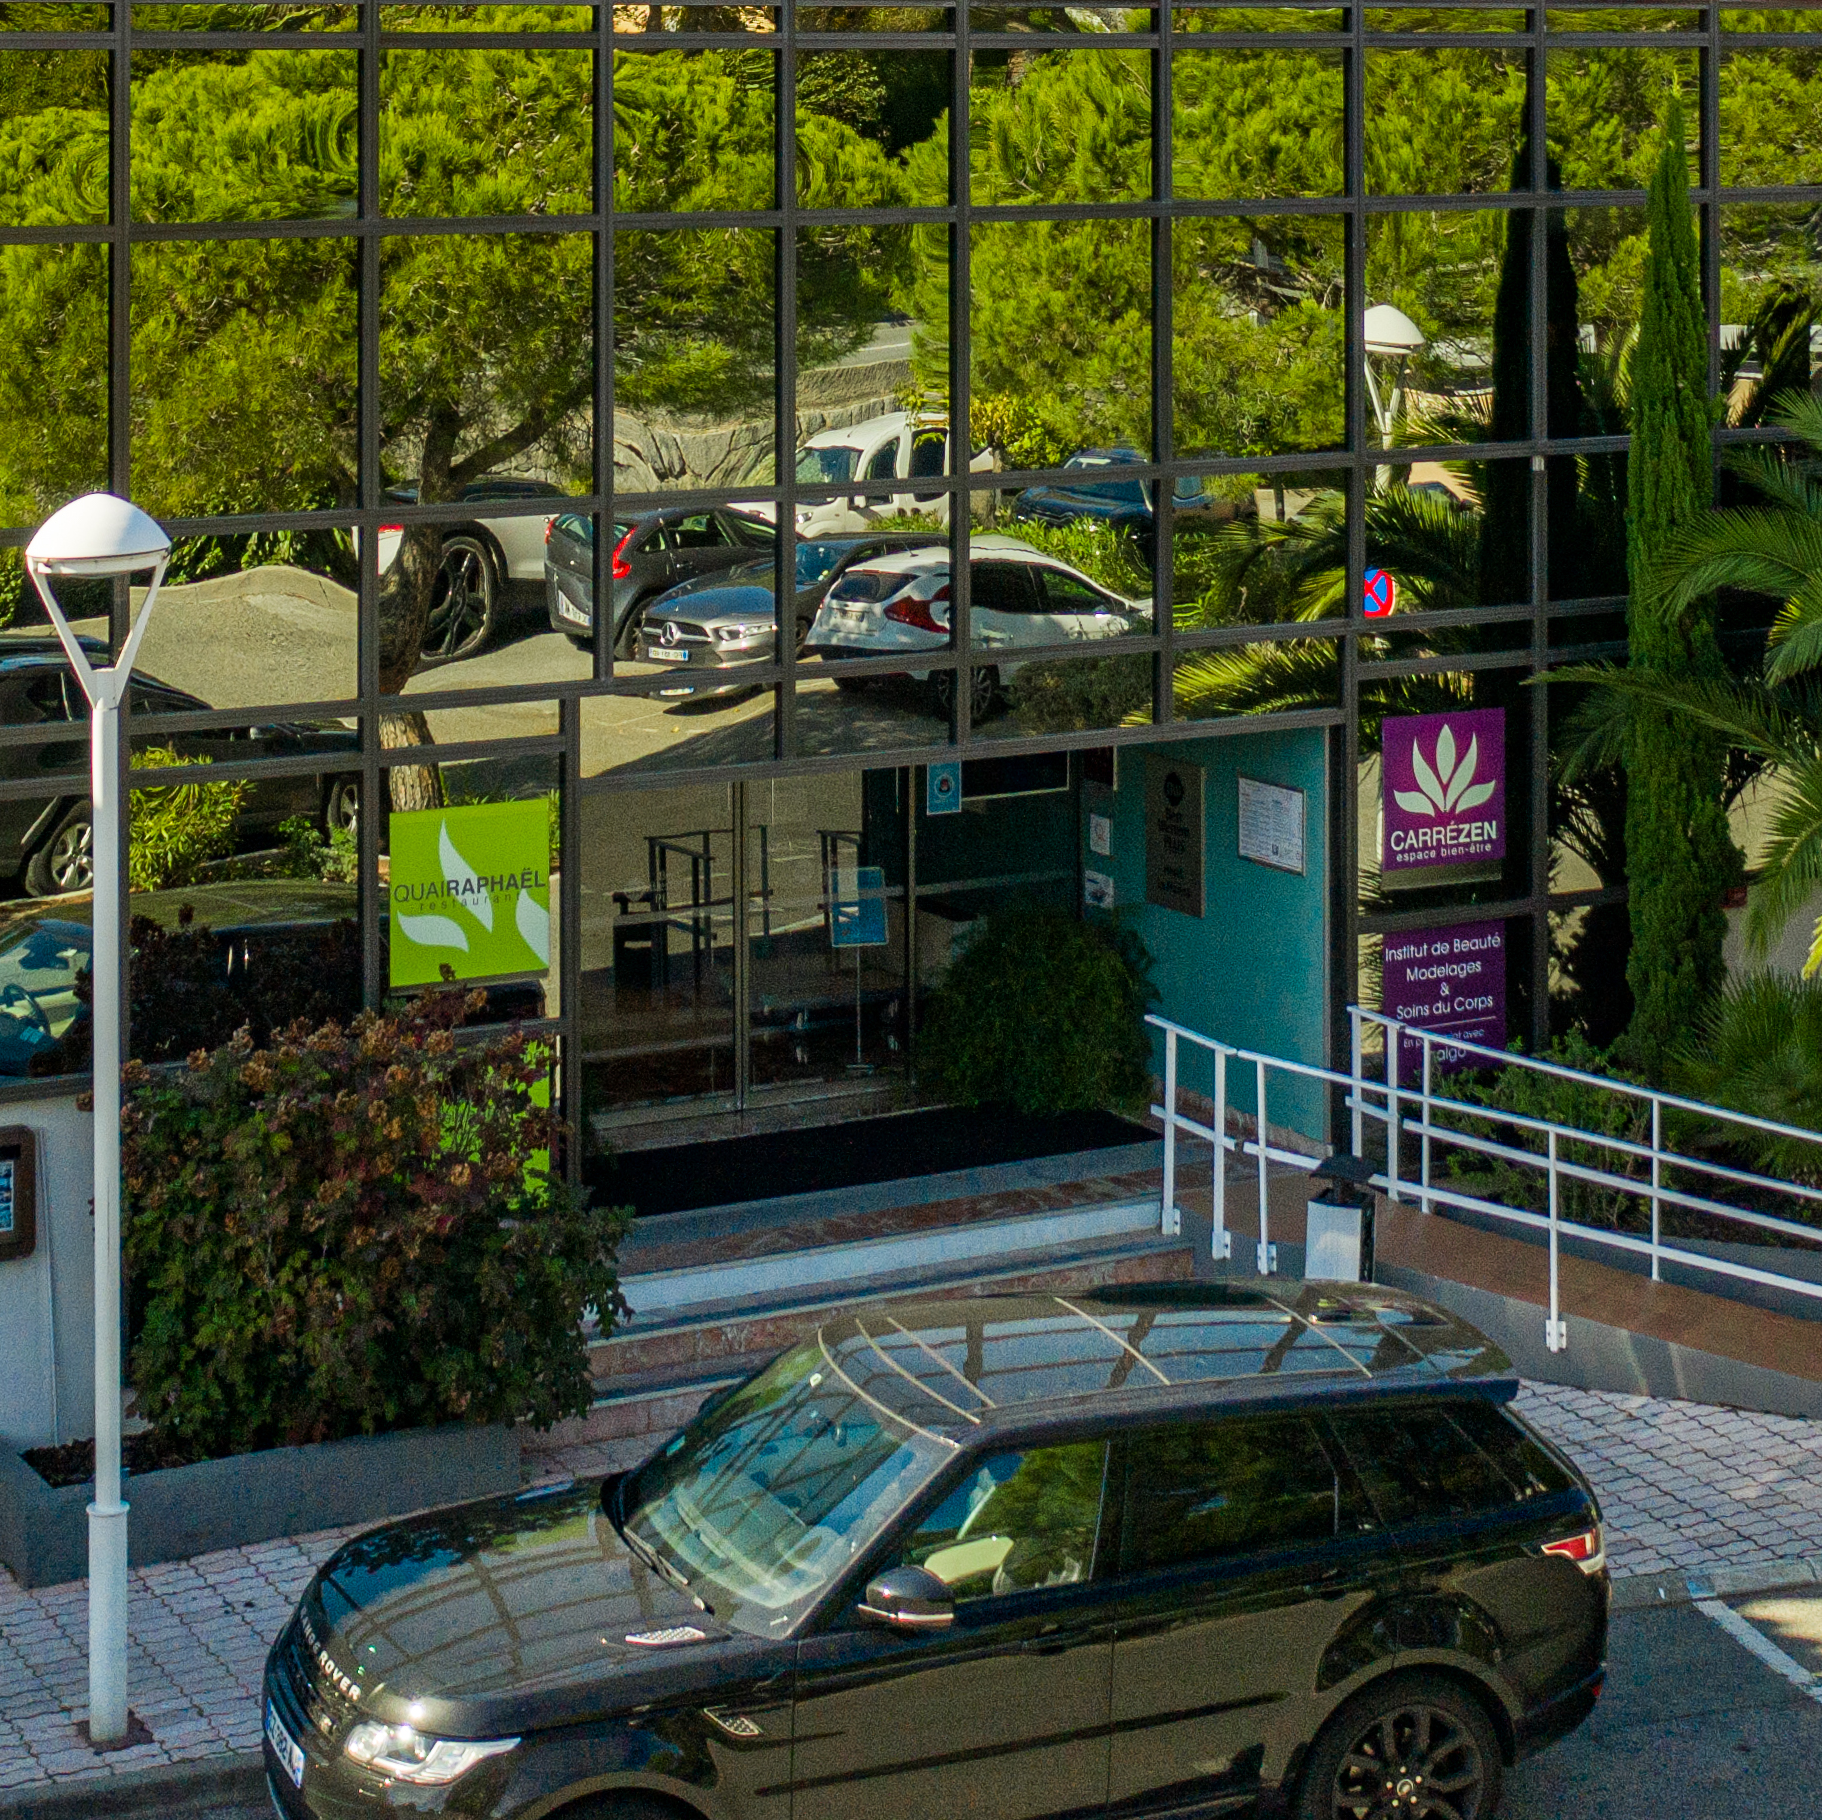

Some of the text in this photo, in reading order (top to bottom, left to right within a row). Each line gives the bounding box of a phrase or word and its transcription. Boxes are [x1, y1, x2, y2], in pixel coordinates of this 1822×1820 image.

[1390, 820, 1497, 851] CARRÉZEN
[1396, 842, 1492, 863] espace bien-être
[1385, 931, 1501, 961] Institut de Beauté
[1406, 960, 1482, 982] Modelages
[1439, 981, 1450, 996] &
[1396, 995, 1493, 1020] Soins du Corps
[319, 1650, 362, 1701] ROVER
